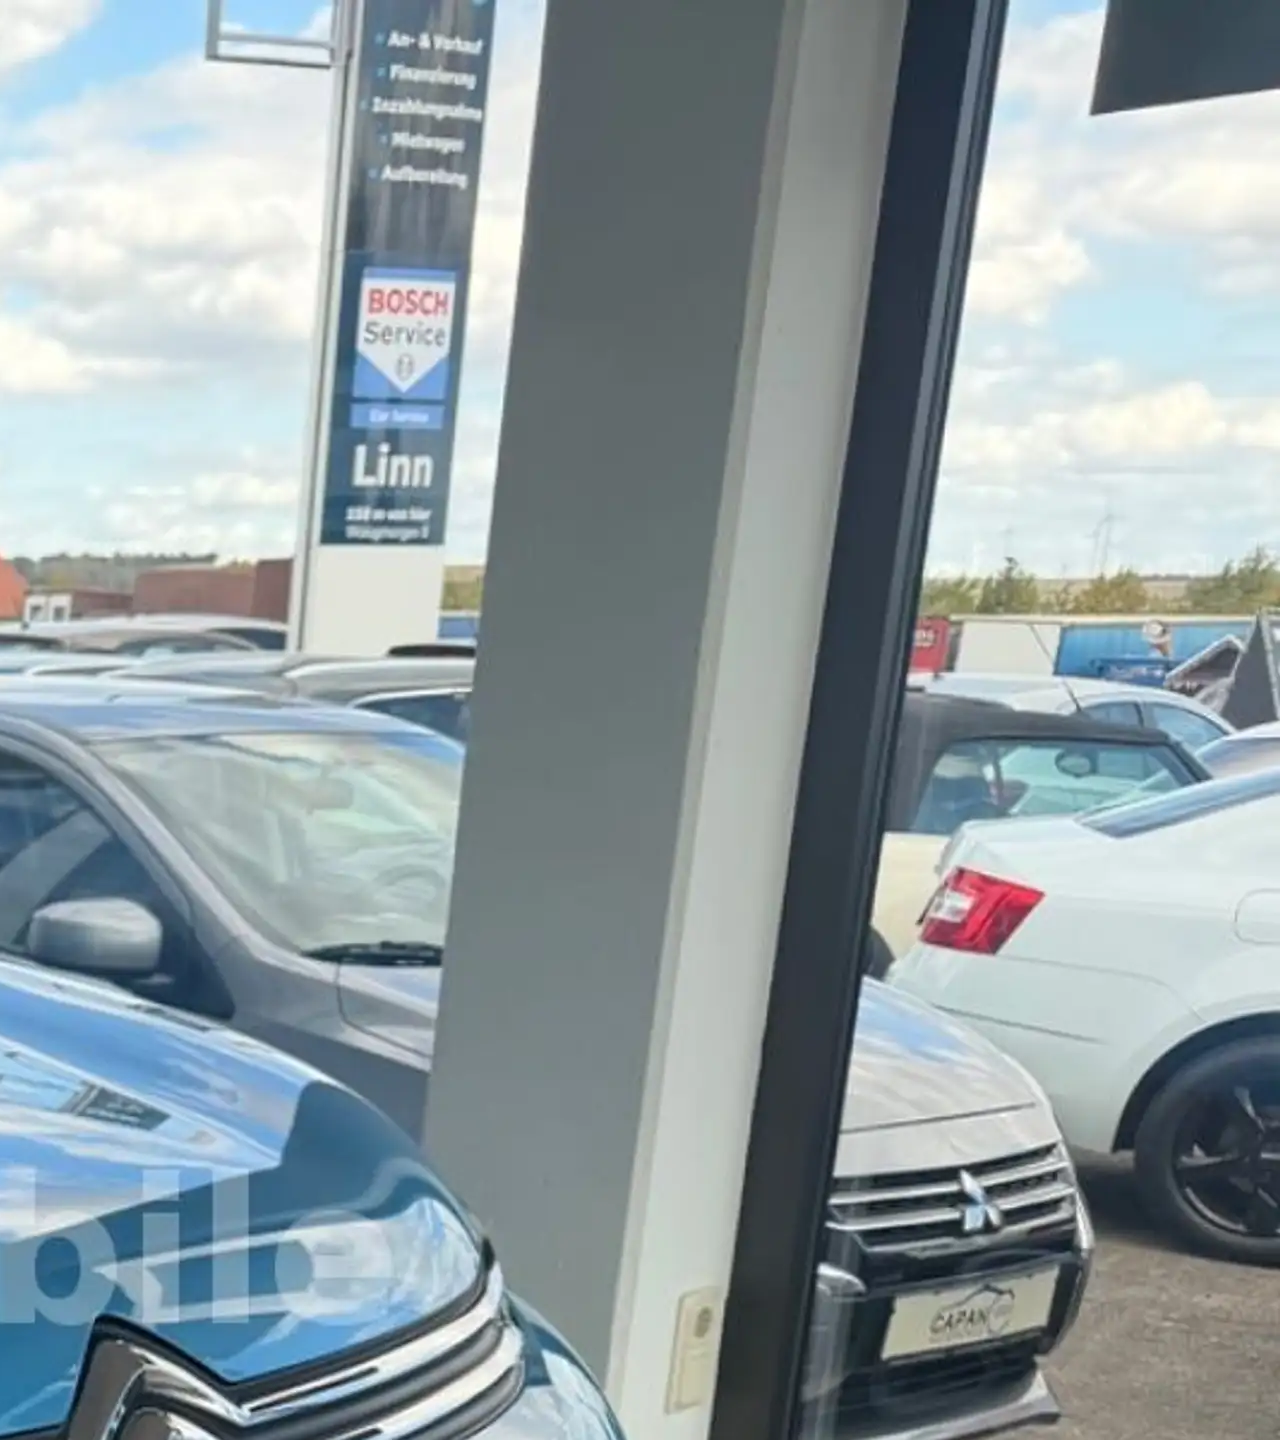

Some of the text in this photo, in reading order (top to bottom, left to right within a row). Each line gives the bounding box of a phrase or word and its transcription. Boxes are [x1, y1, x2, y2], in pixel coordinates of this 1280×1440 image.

[367, 288, 448, 316] BOSCH
[363, 321, 446, 347] Service
[352, 442, 434, 488] Linn
